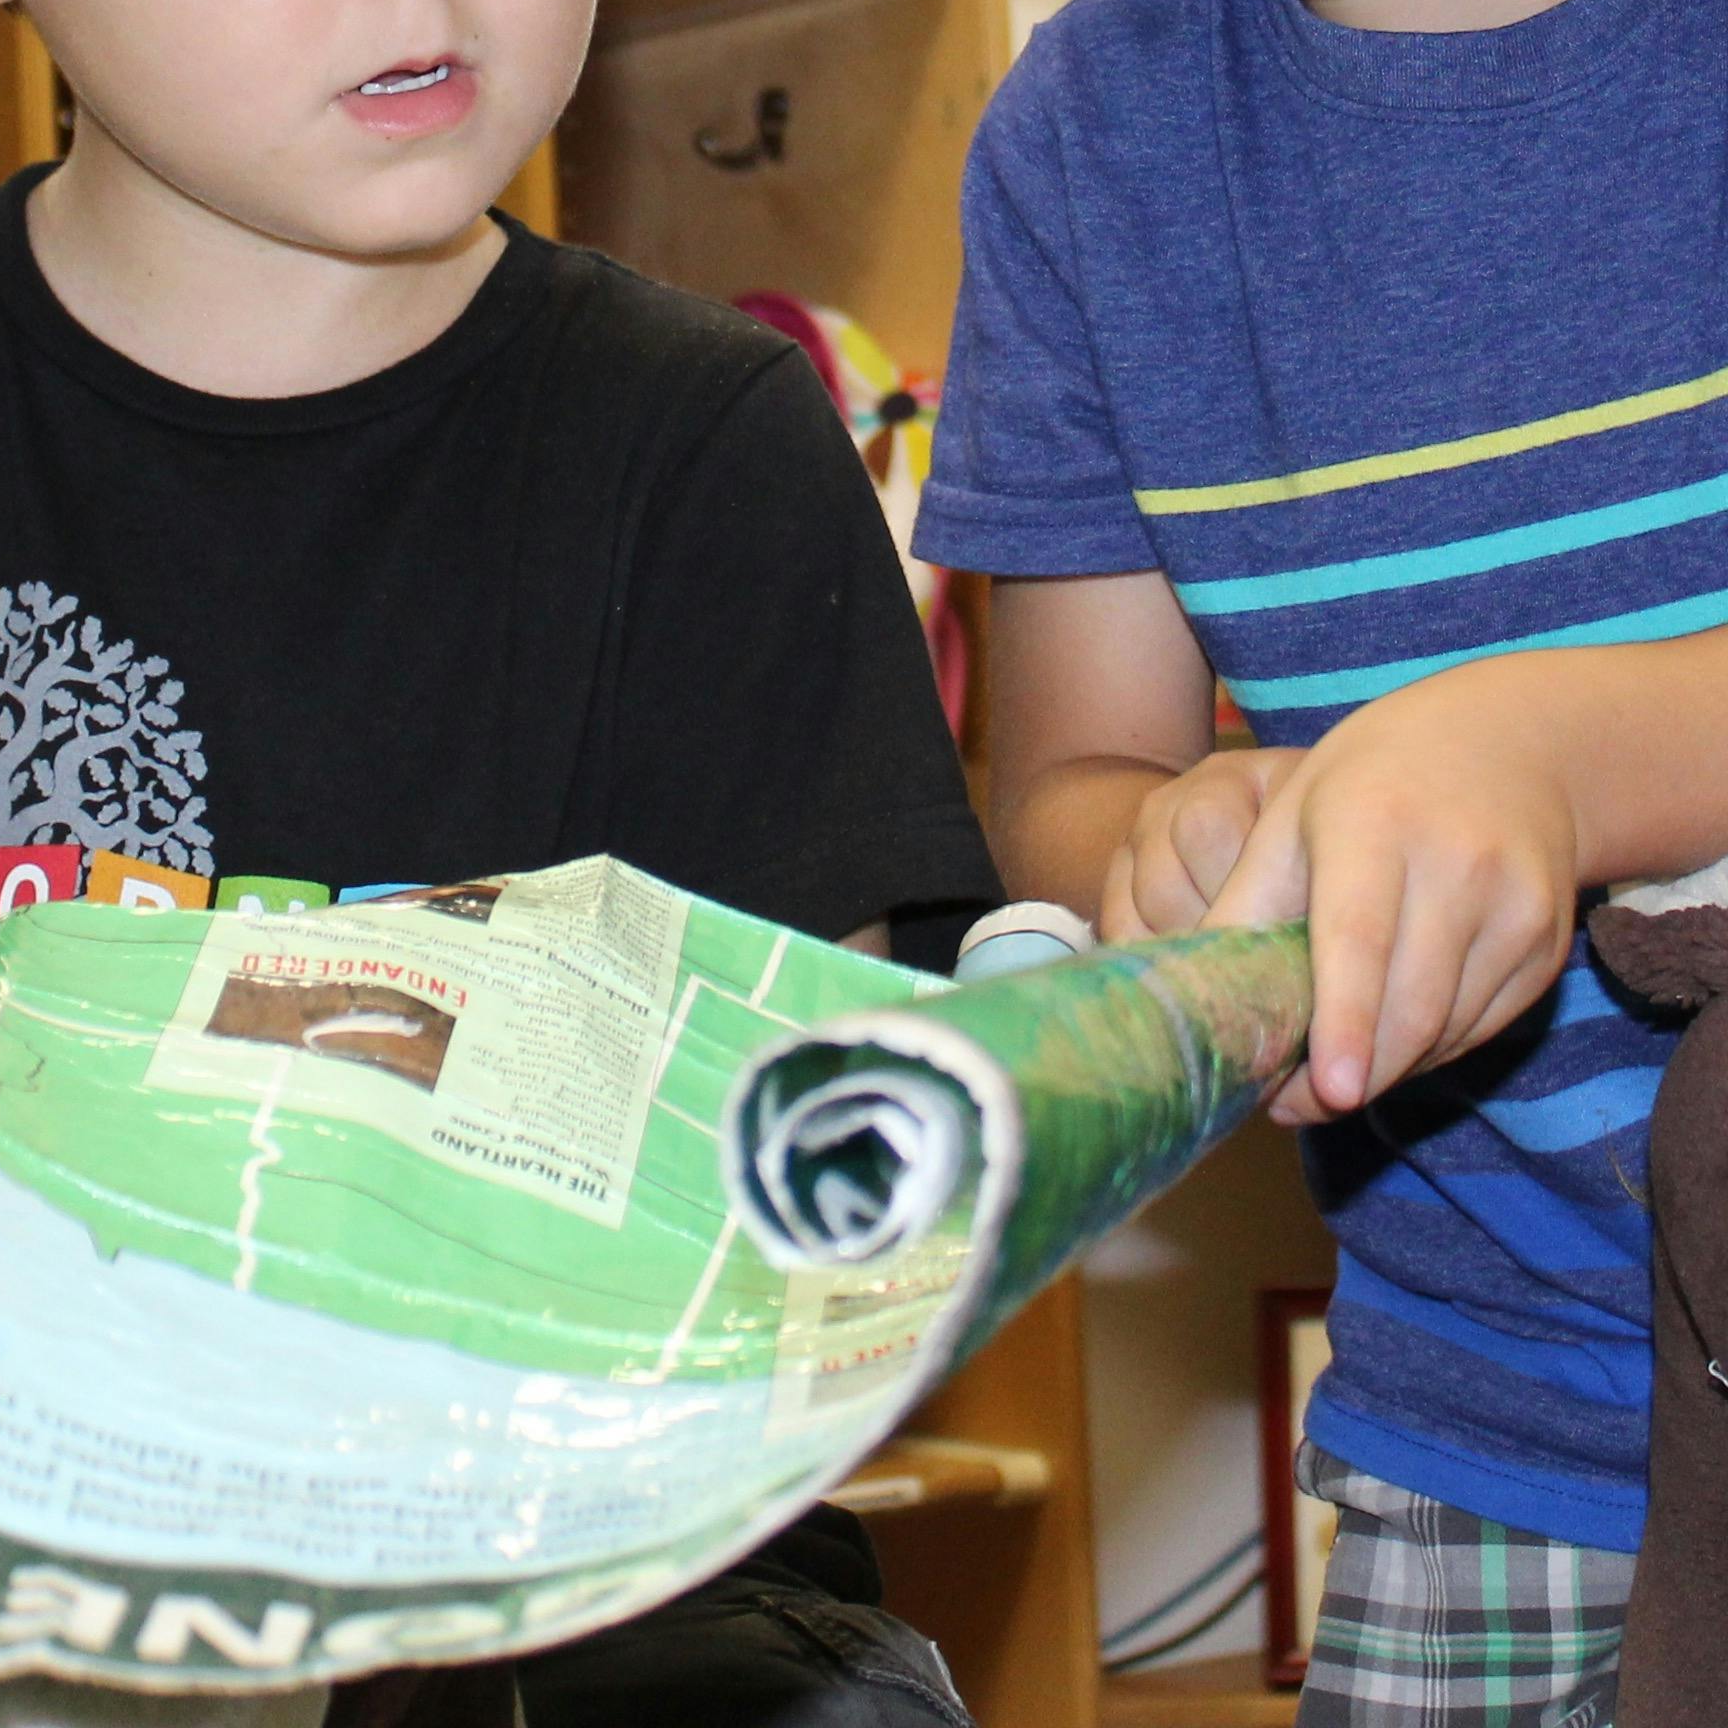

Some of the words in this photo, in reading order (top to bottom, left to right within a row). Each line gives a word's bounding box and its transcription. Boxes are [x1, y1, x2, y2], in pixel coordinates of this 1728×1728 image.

[241, 953, 467, 1009] ENDANGERED
[431, 1128, 562, 1184] HEARTLAND
[511, 1133, 611, 1182] Whooping
[568, 1175, 608, 1202] THE
